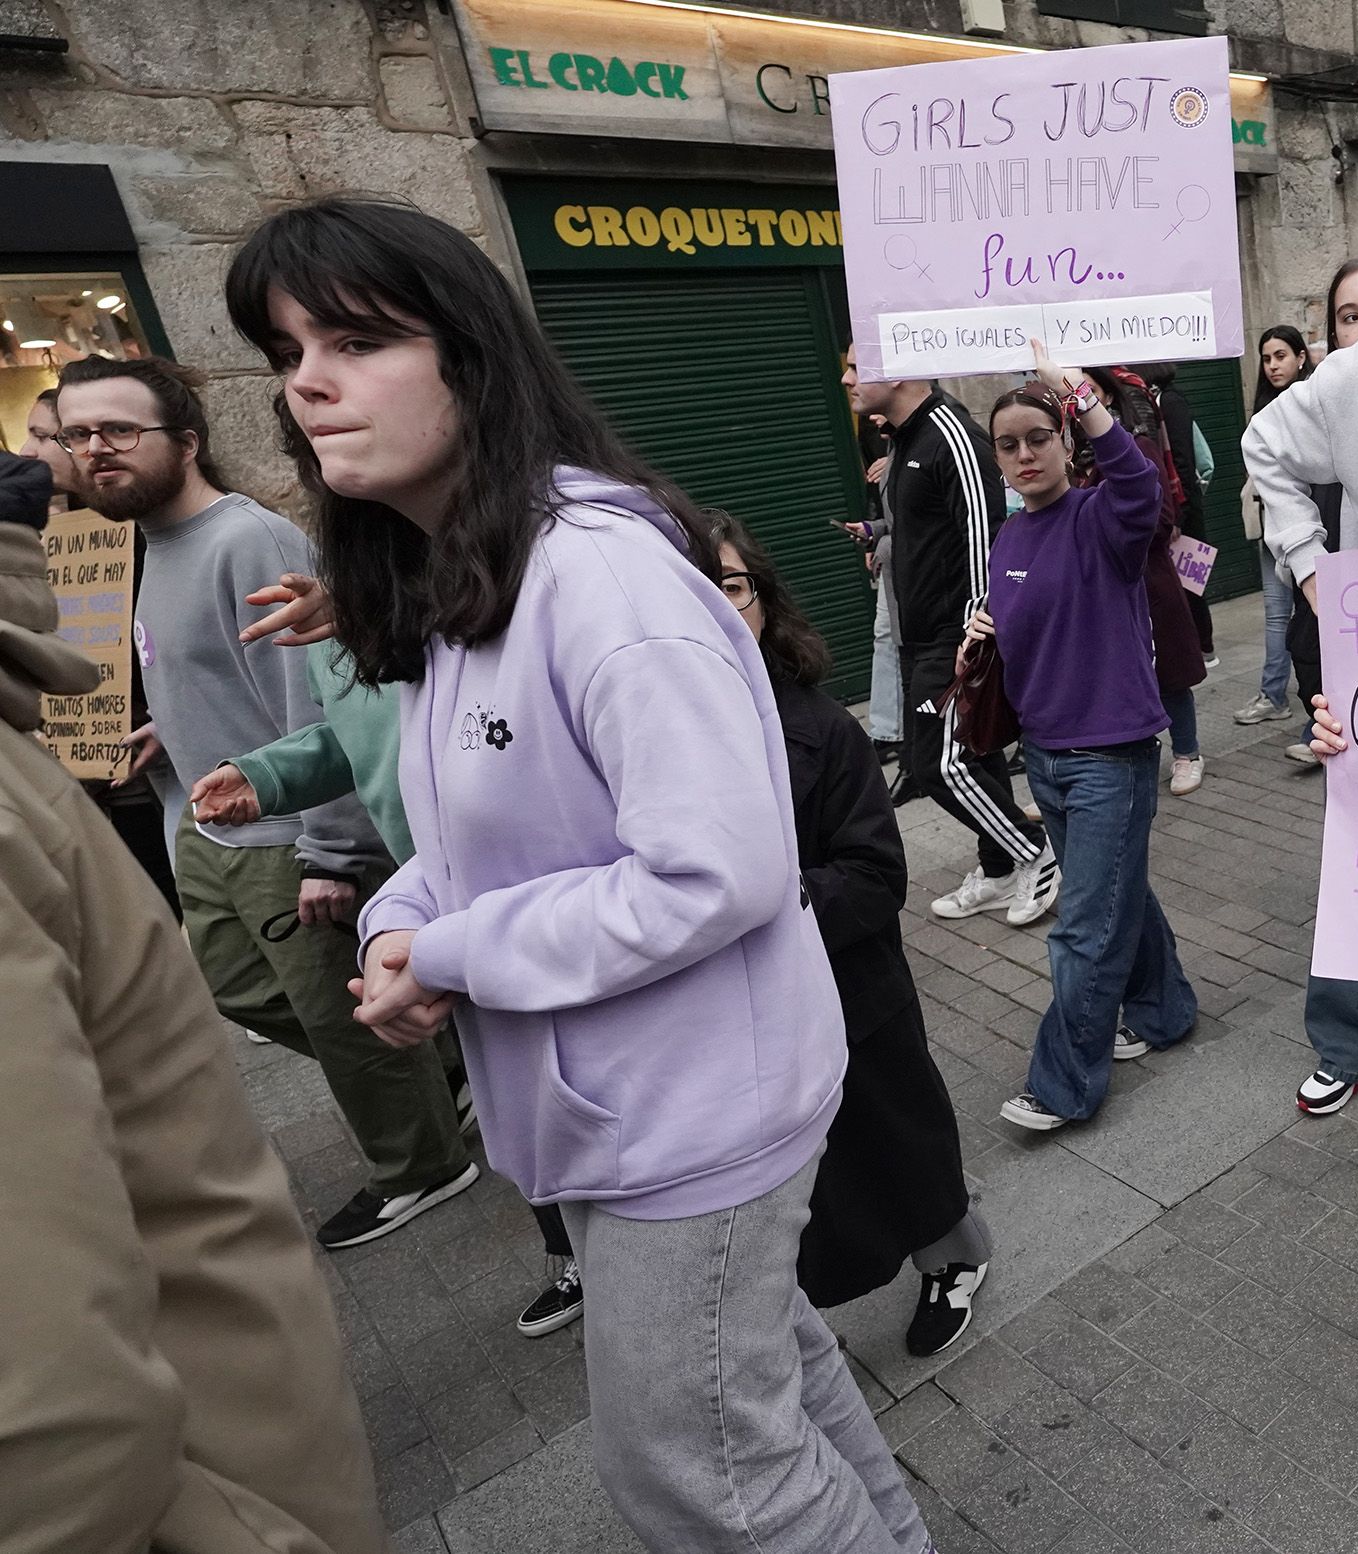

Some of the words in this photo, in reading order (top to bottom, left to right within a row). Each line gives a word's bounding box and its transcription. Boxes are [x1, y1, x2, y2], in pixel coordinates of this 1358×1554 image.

[488, 47, 548, 89] EL
[1042, 77, 1171, 141] JUST
[873, 158, 1029, 225] WANNA
[1045, 156, 1160, 214] HAVE
[892, 322, 947, 355] PERO
[1055, 319, 1070, 345] Y
[1121, 315, 1207, 343] MIEDO!!!
[47, 535, 63, 557] EN
[67, 533, 85, 554] UN
[89, 526, 127, 551] MUNDO
[63, 566, 73, 586] EL
[77, 562, 99, 584] QUE
[103, 561, 126, 583] HAY
[47, 696, 84, 718] TANTOS
[87, 694, 126, 716] HOMBRES
[45, 721, 86, 739] OPINANDO
[91, 720, 122, 736] SOBRE
